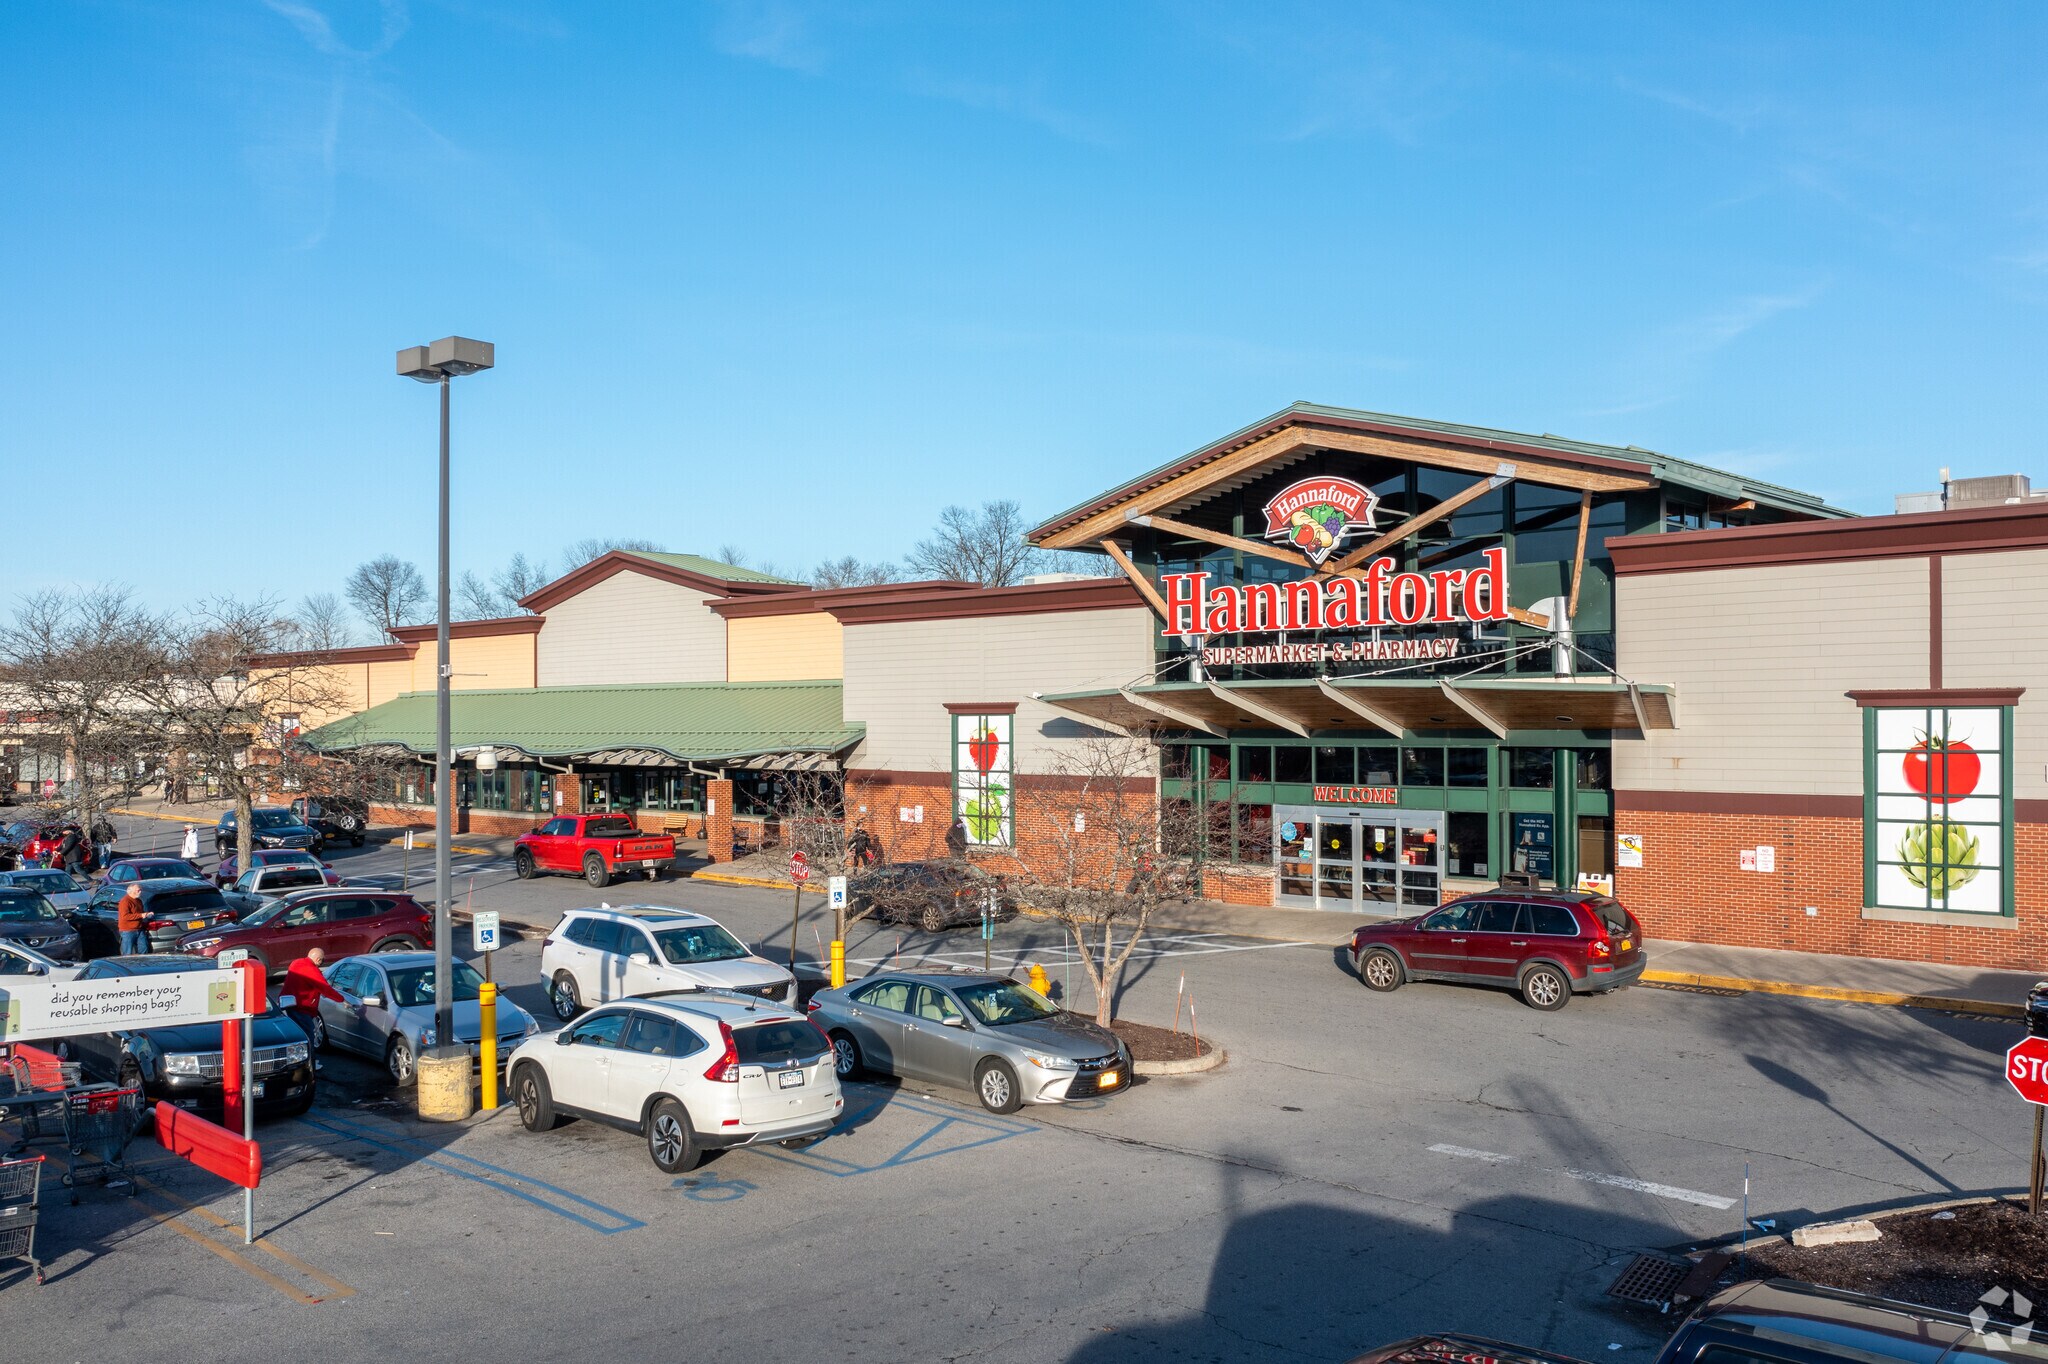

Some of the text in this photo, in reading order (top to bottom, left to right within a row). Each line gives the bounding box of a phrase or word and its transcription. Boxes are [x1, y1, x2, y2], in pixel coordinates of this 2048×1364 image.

[1275, 485, 1361, 519] Hannaford
[1161, 547, 1512, 637] Hannaford
[1202, 638, 1459, 666] SUPERMARKET & PHARMACY
[1313, 785, 1398, 804] WELCOME
[791, 860, 809, 877] STOP
[50, 994, 182, 1018] reusable shopping bags?
[51, 985, 182, 1006] did you remember your
